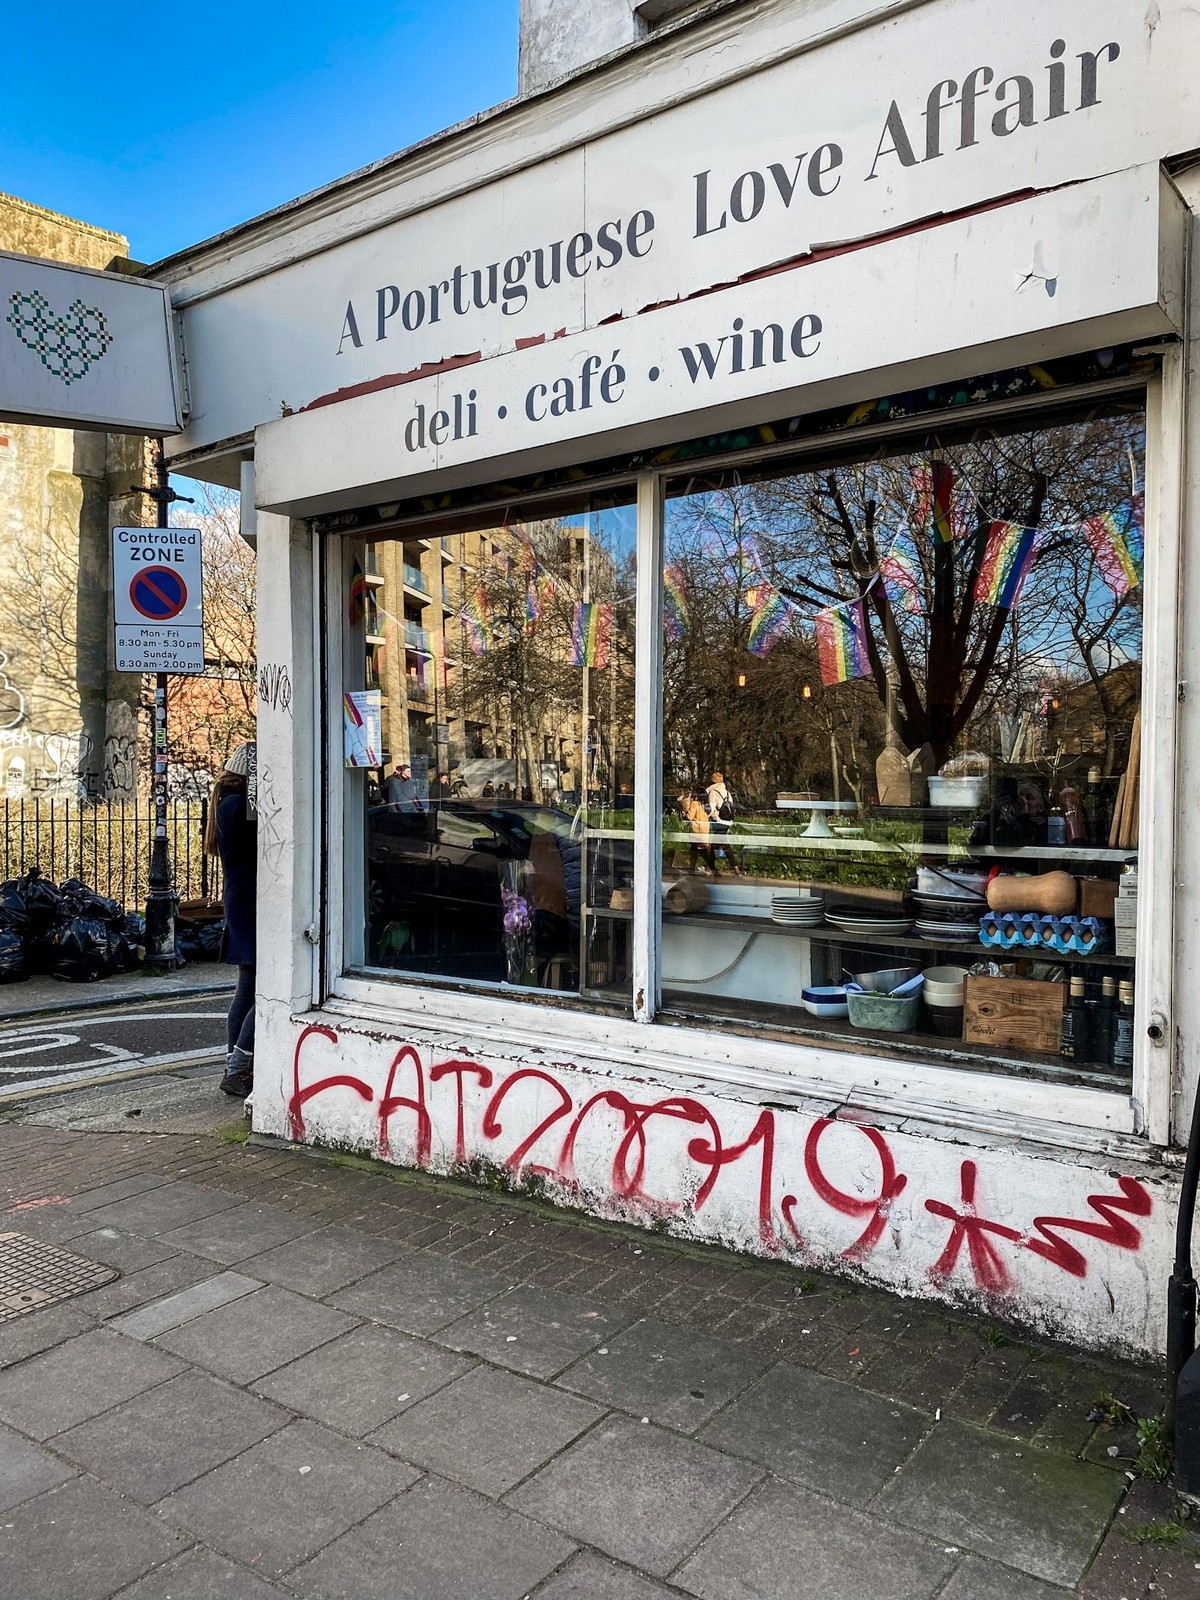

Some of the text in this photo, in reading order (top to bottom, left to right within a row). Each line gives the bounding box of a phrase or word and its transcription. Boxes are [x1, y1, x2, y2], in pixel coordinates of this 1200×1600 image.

[336, 38, 1121, 355] A Portuguese Love Affair
[404, 389, 480, 454] deli
[524, 348, 627, 422] café
[678, 313, 823, 385] wine
[118, 531, 196, 545] Controlled
[129, 547, 185, 562] ZONE
[118, 638, 142, 647] 8.30
[163, 639, 186, 648] 5.30
[186, 641, 201, 649] pm
[143, 650, 178, 660] Sunday
[119, 659, 142, 668] 8.30
[163, 660, 186, 669] 2.00
[187, 662, 202, 670] pm
